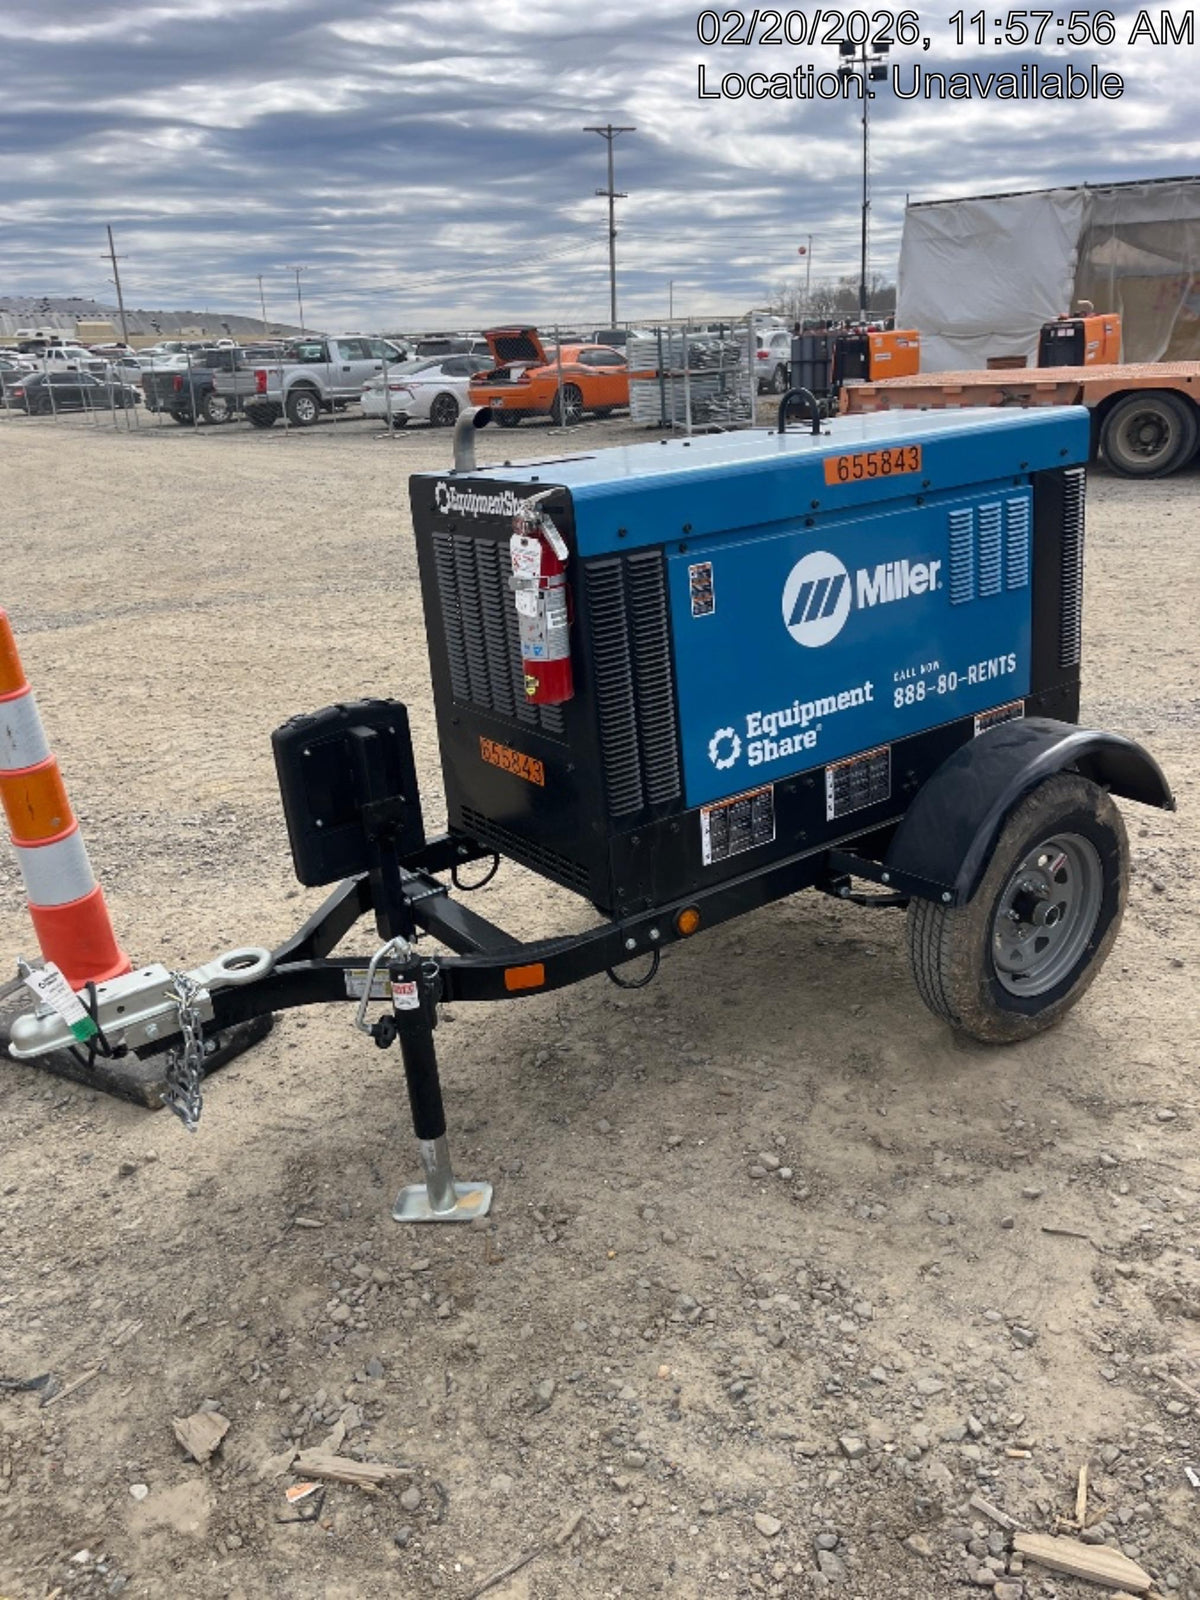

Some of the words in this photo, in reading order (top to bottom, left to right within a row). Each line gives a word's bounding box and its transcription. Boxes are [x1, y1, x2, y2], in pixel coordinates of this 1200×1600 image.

[837, 446, 920, 482] 655843
[857, 559, 942, 608] Miller
[893, 667, 917, 682] CALL
[920, 660, 940, 675] NOW
[893, 652, 1017, 709] 888-80-RENTS
[745, 680, 874, 739] Equipment
[482, 740, 542, 783] 655843
[747, 729, 818, 767] Share
